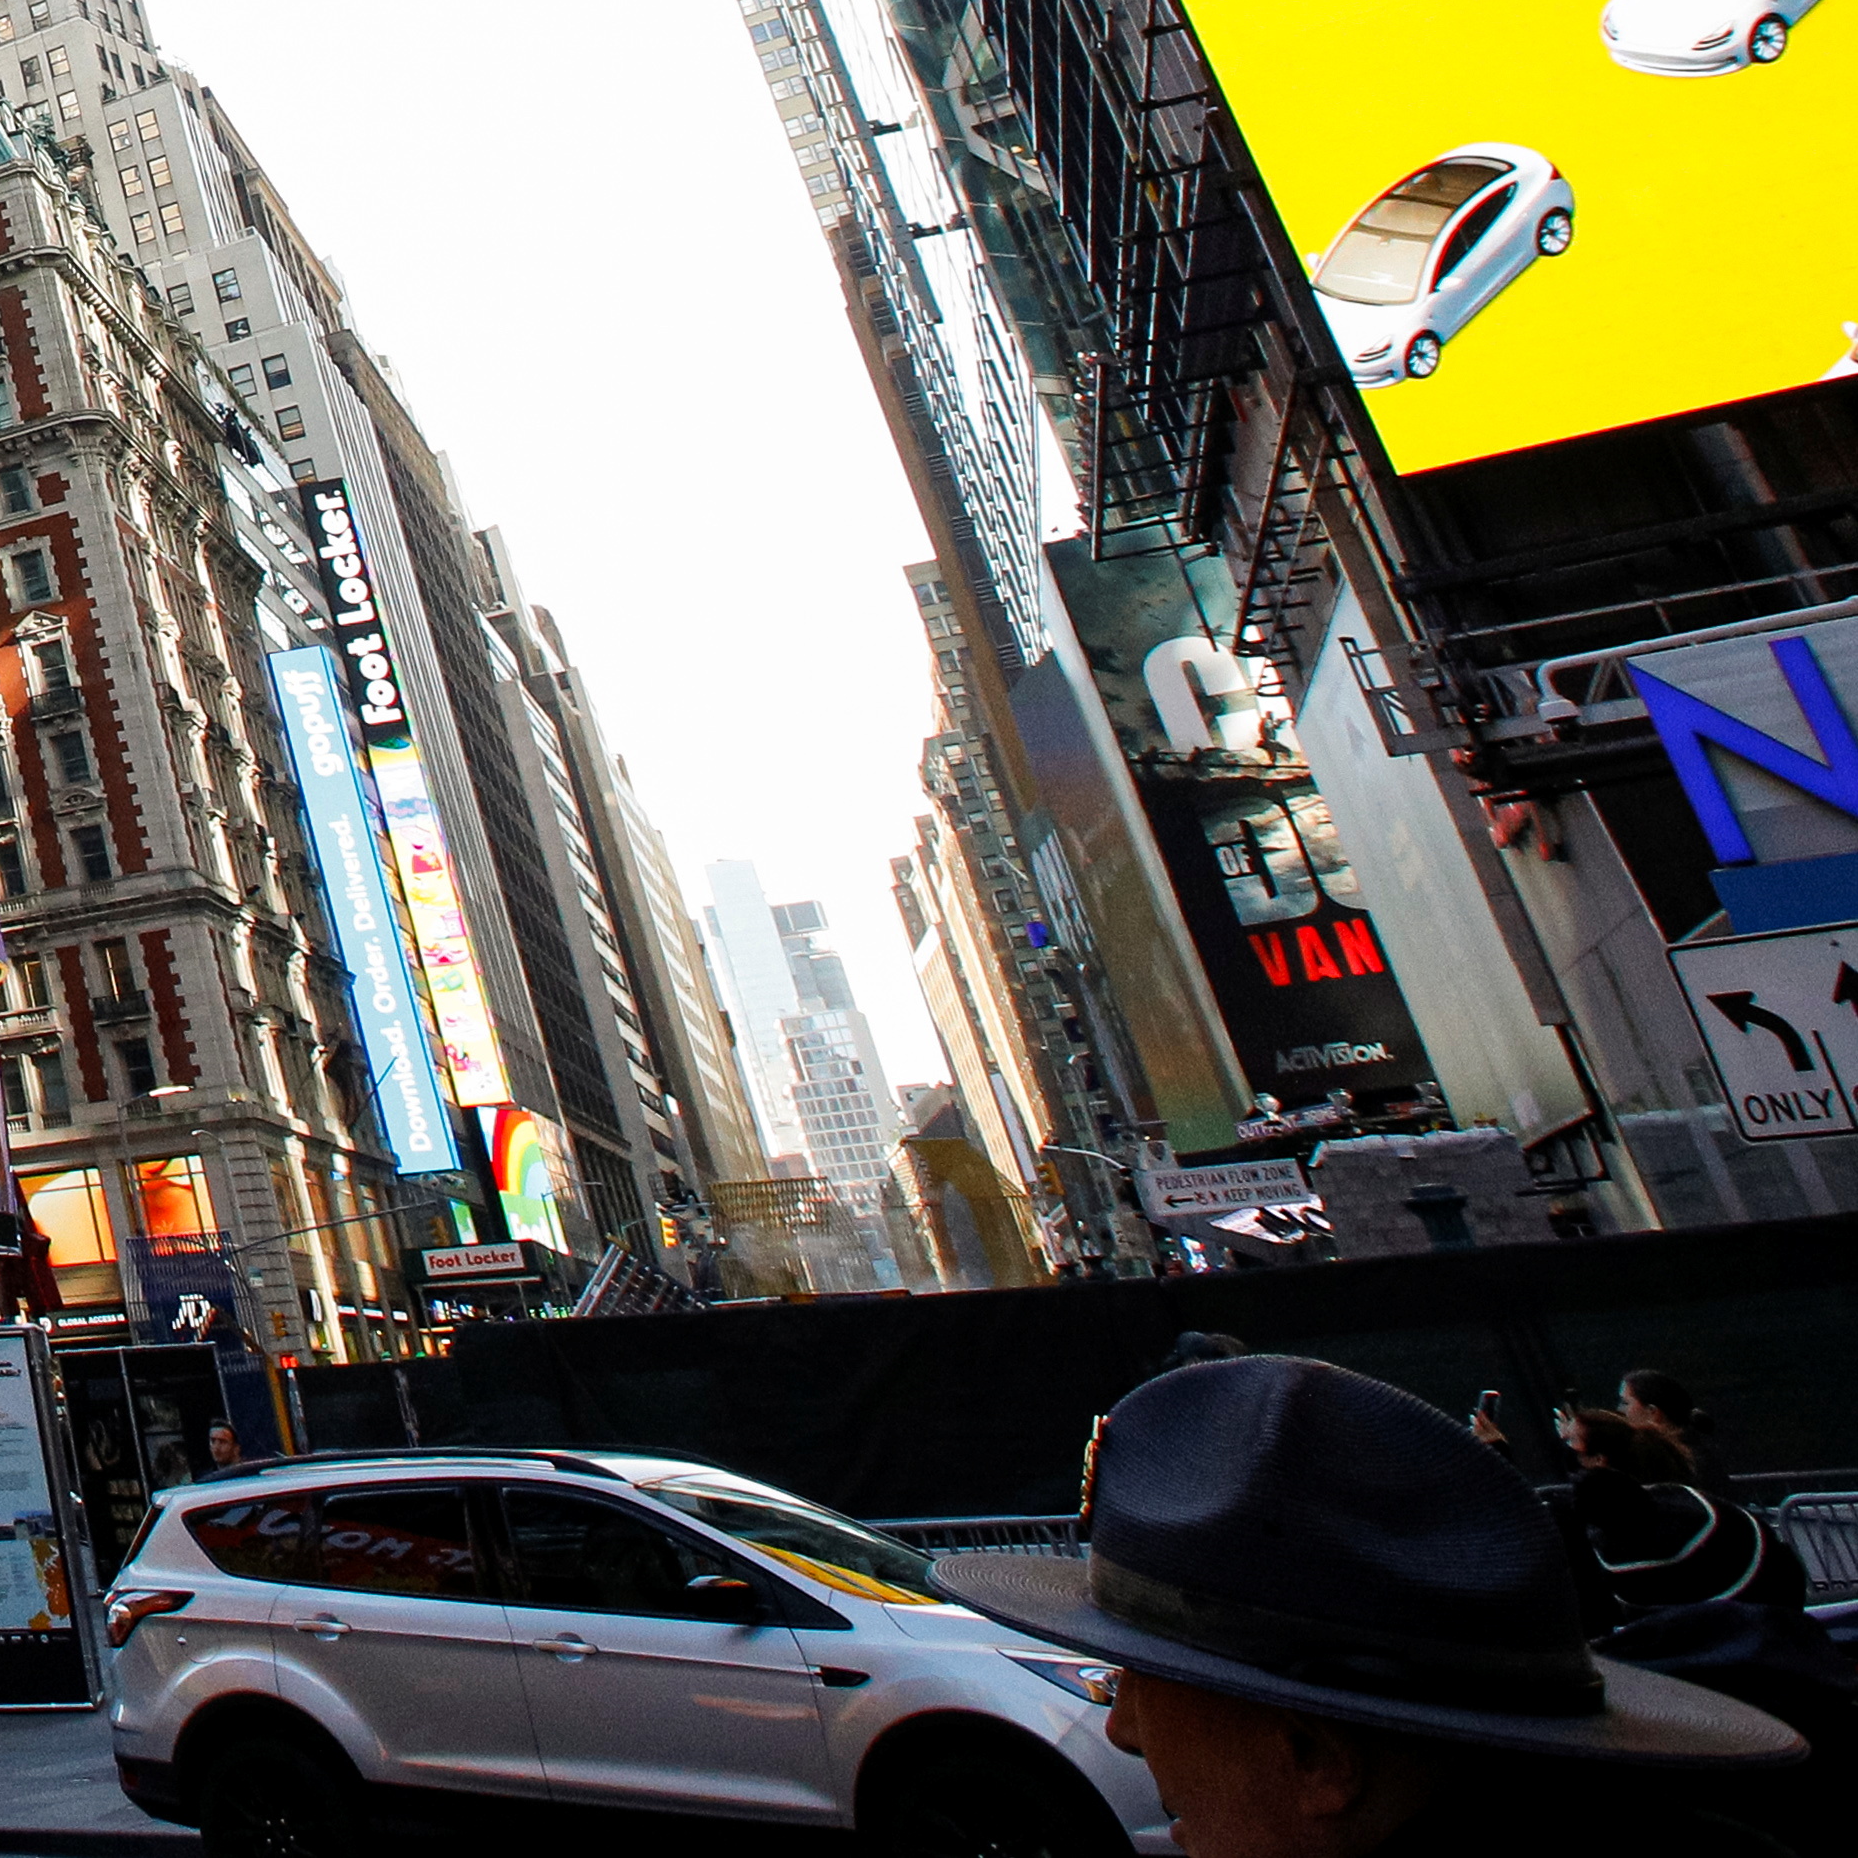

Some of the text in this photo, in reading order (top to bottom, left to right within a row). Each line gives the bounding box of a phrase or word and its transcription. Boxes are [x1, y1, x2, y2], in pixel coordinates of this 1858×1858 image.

[346, 632, 404, 726] Foot
[282, 669, 345, 777] gopuff
[1216, 845, 1254, 877] OF
[1247, 918, 1385, 987] VAN
[328, 812, 432, 1154] Download. Order. Delivered.
[1744, 1090, 1835, 1127] ONLY
[1156, 1164, 1295, 1191] PEDESTRIAN FLOW ZONE
[1223, 1183, 1301, 1203] KEEP MOVING
[429, 1250, 516, 1270] Foot Locker
